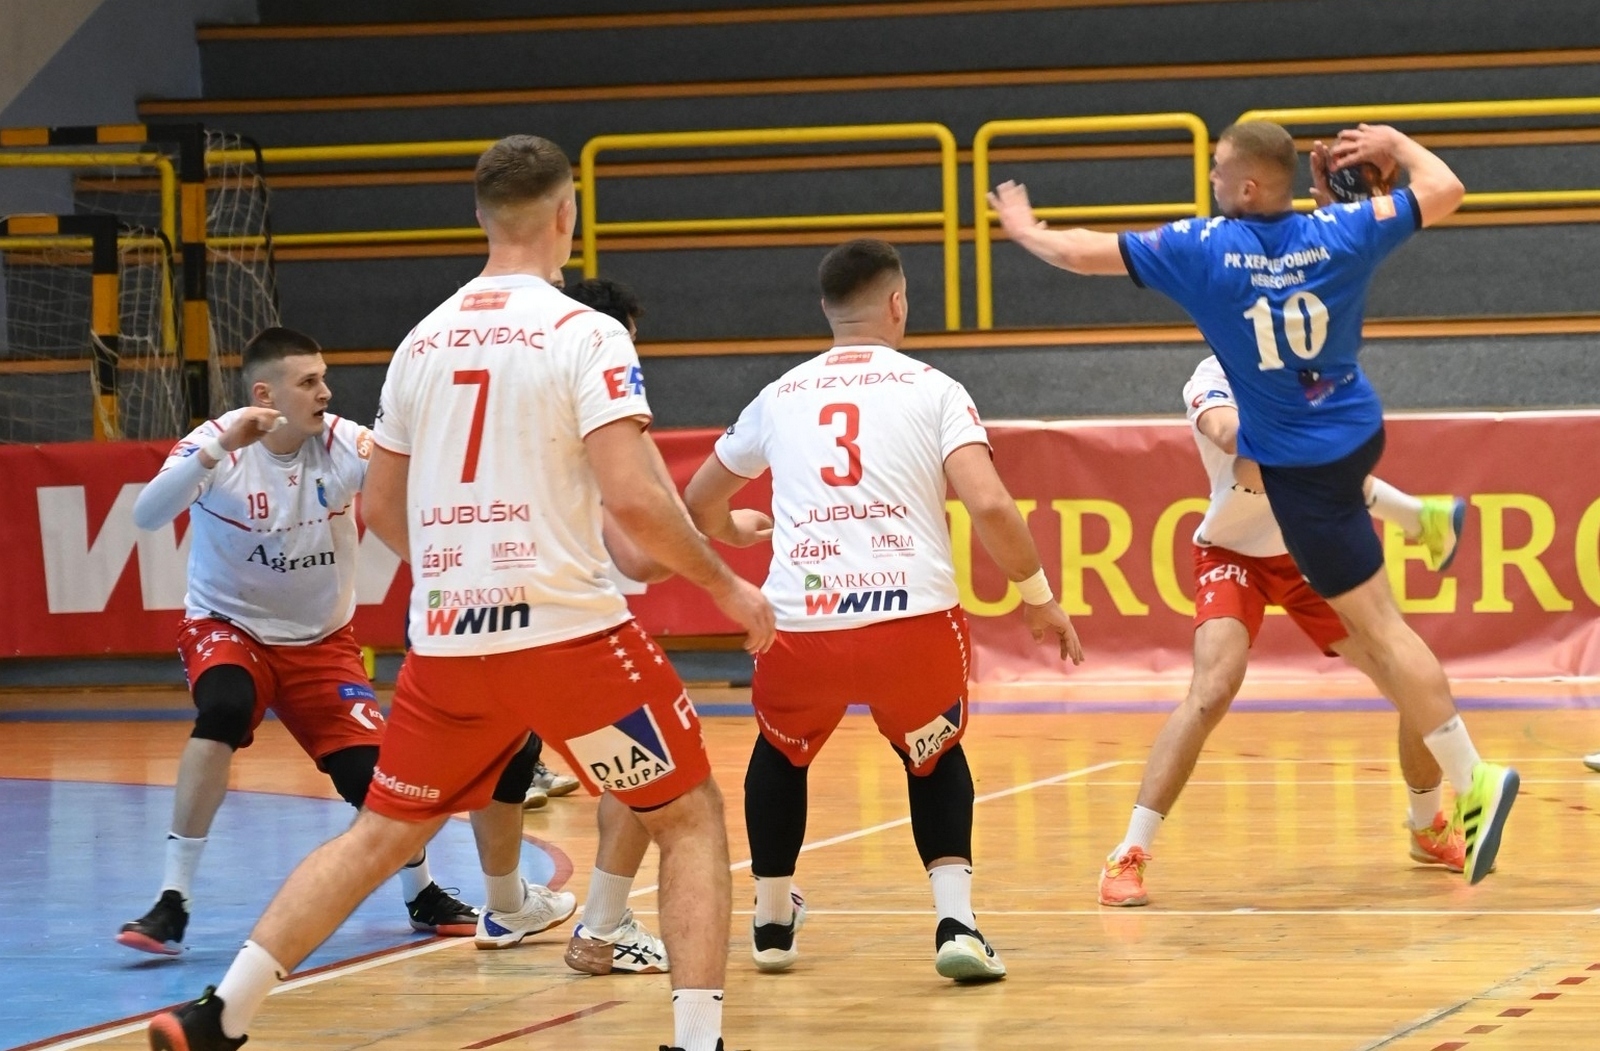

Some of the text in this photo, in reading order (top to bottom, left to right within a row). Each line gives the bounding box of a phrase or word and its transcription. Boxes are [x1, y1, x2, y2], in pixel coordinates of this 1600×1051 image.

[411, 331, 440, 359] RK
[1243, 291, 1330, 372] 10
[777, 378, 808, 398] RK
[453, 368, 491, 484] 7
[818, 402, 863, 487] 3
[247, 492, 270, 520] 19
[871, 535, 915, 549] MRM
[822, 571, 907, 589] PARKOVI
[442, 586, 528, 607] PARKOVI
[590, 745, 650, 781] DIA
